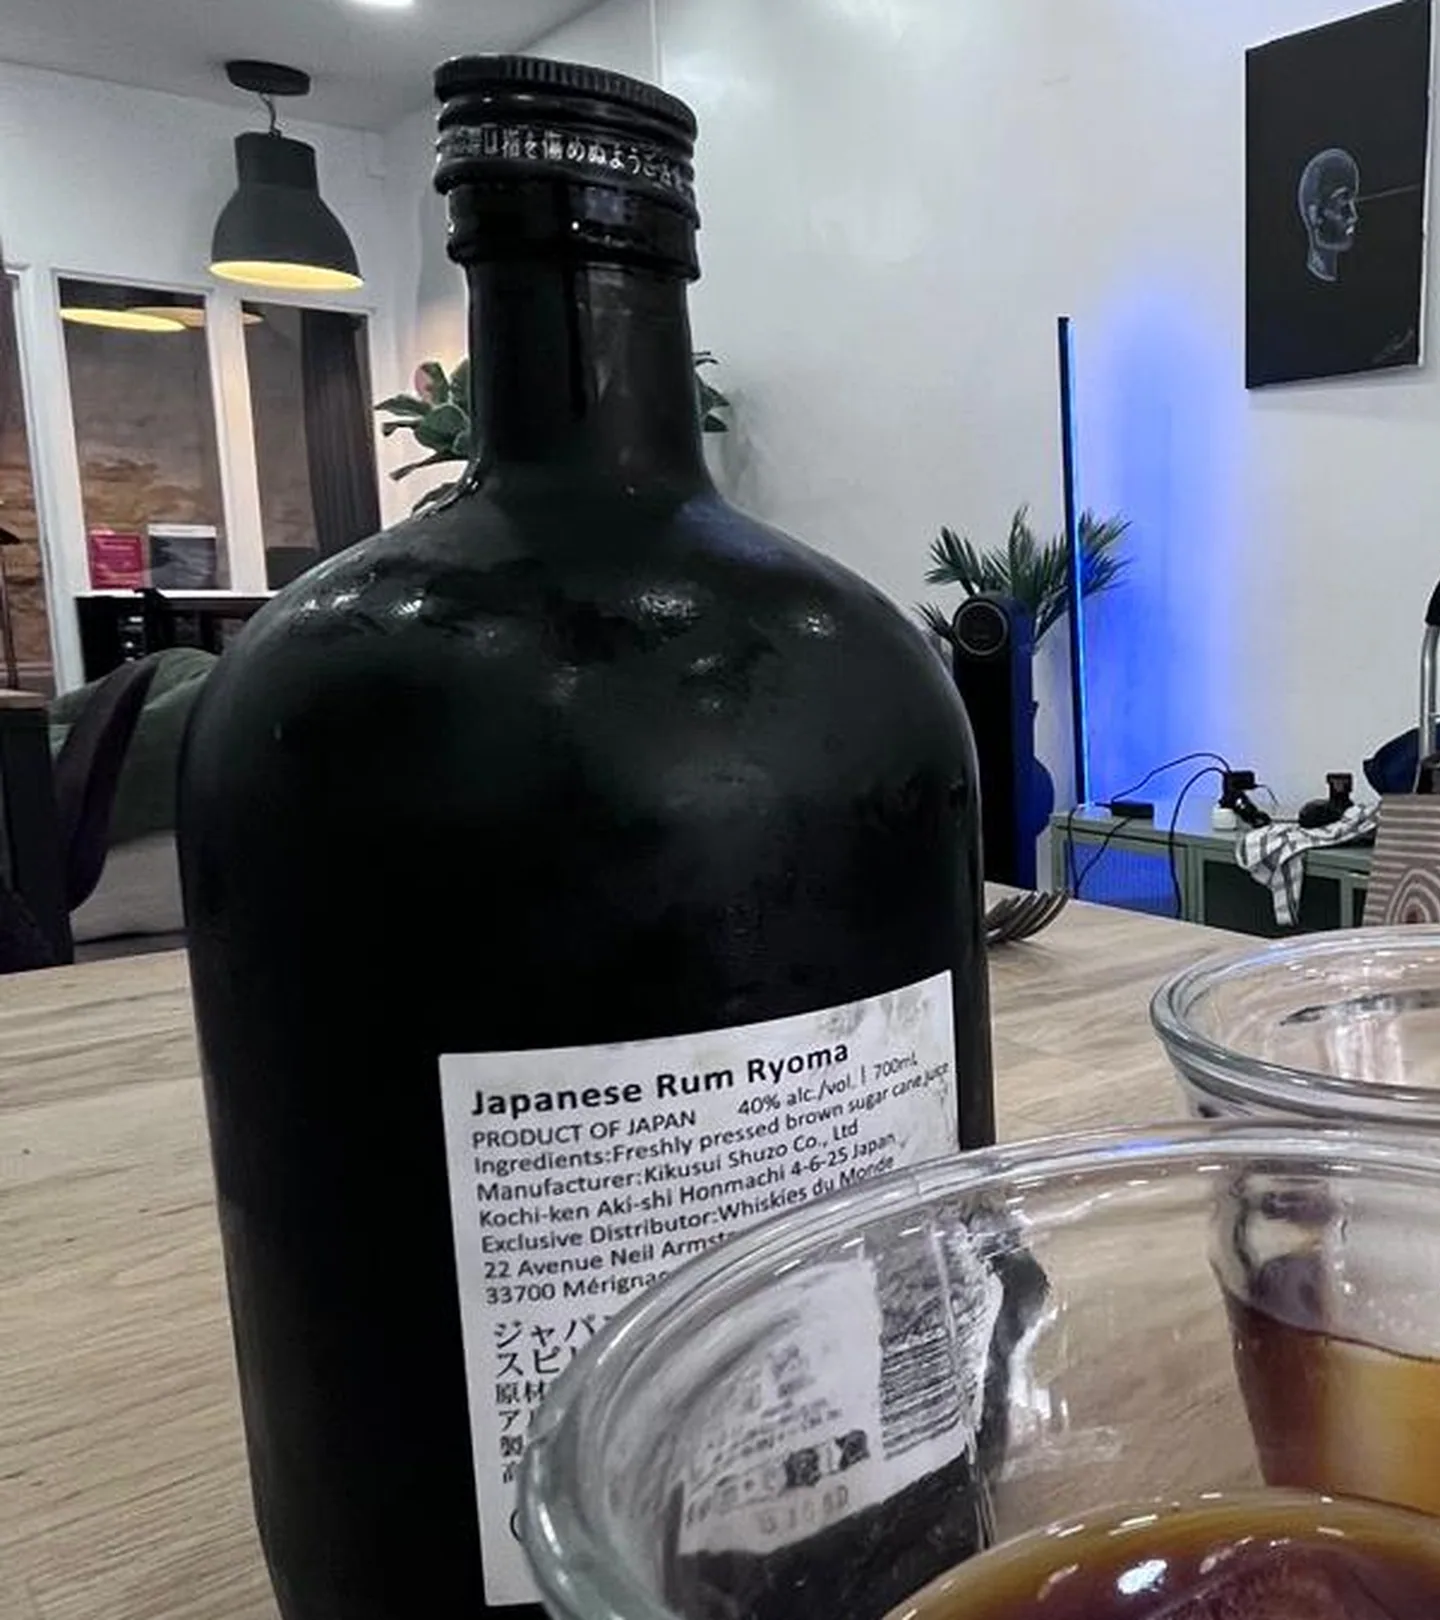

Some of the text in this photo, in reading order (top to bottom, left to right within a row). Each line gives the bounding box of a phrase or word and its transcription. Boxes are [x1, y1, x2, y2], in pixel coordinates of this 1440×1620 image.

[471, 1043, 849, 1120] Japanese Rum Ryoma
[472, 1124, 582, 1149] PRODUCT
[590, 1120, 621, 1139] OF
[627, 1110, 696, 1136] JAPAN
[738, 1093, 781, 1116] 40%
[700, 1117, 779, 1151] pressed
[786, 1104, 843, 1130] brown
[849, 1088, 888, 1111] sugar
[892, 1075, 921, 1097] cane
[728, 1143, 788, 1168] Shuzo
[793, 1134, 828, 1153] Co.,
[833, 1119, 858, 1141] Ltd
[479, 1133, 896, 1228] Kochi-ken Aki-shi Honmachi 4-6-25 Japan
[481, 1231, 583, 1254] Exclusive
[812, 1177, 834, 1197] du
[840, 1155, 895, 1188] Monde
[484, 1260, 511, 1279] 22
[517, 1253, 603, 1277] Avenue
[611, 1243, 654, 1267] Neil
[486, 1283, 556, 1305] 33700
[493, 1314, 612, 1349] ジャパ
[496, 1346, 577, 1378] スピ
